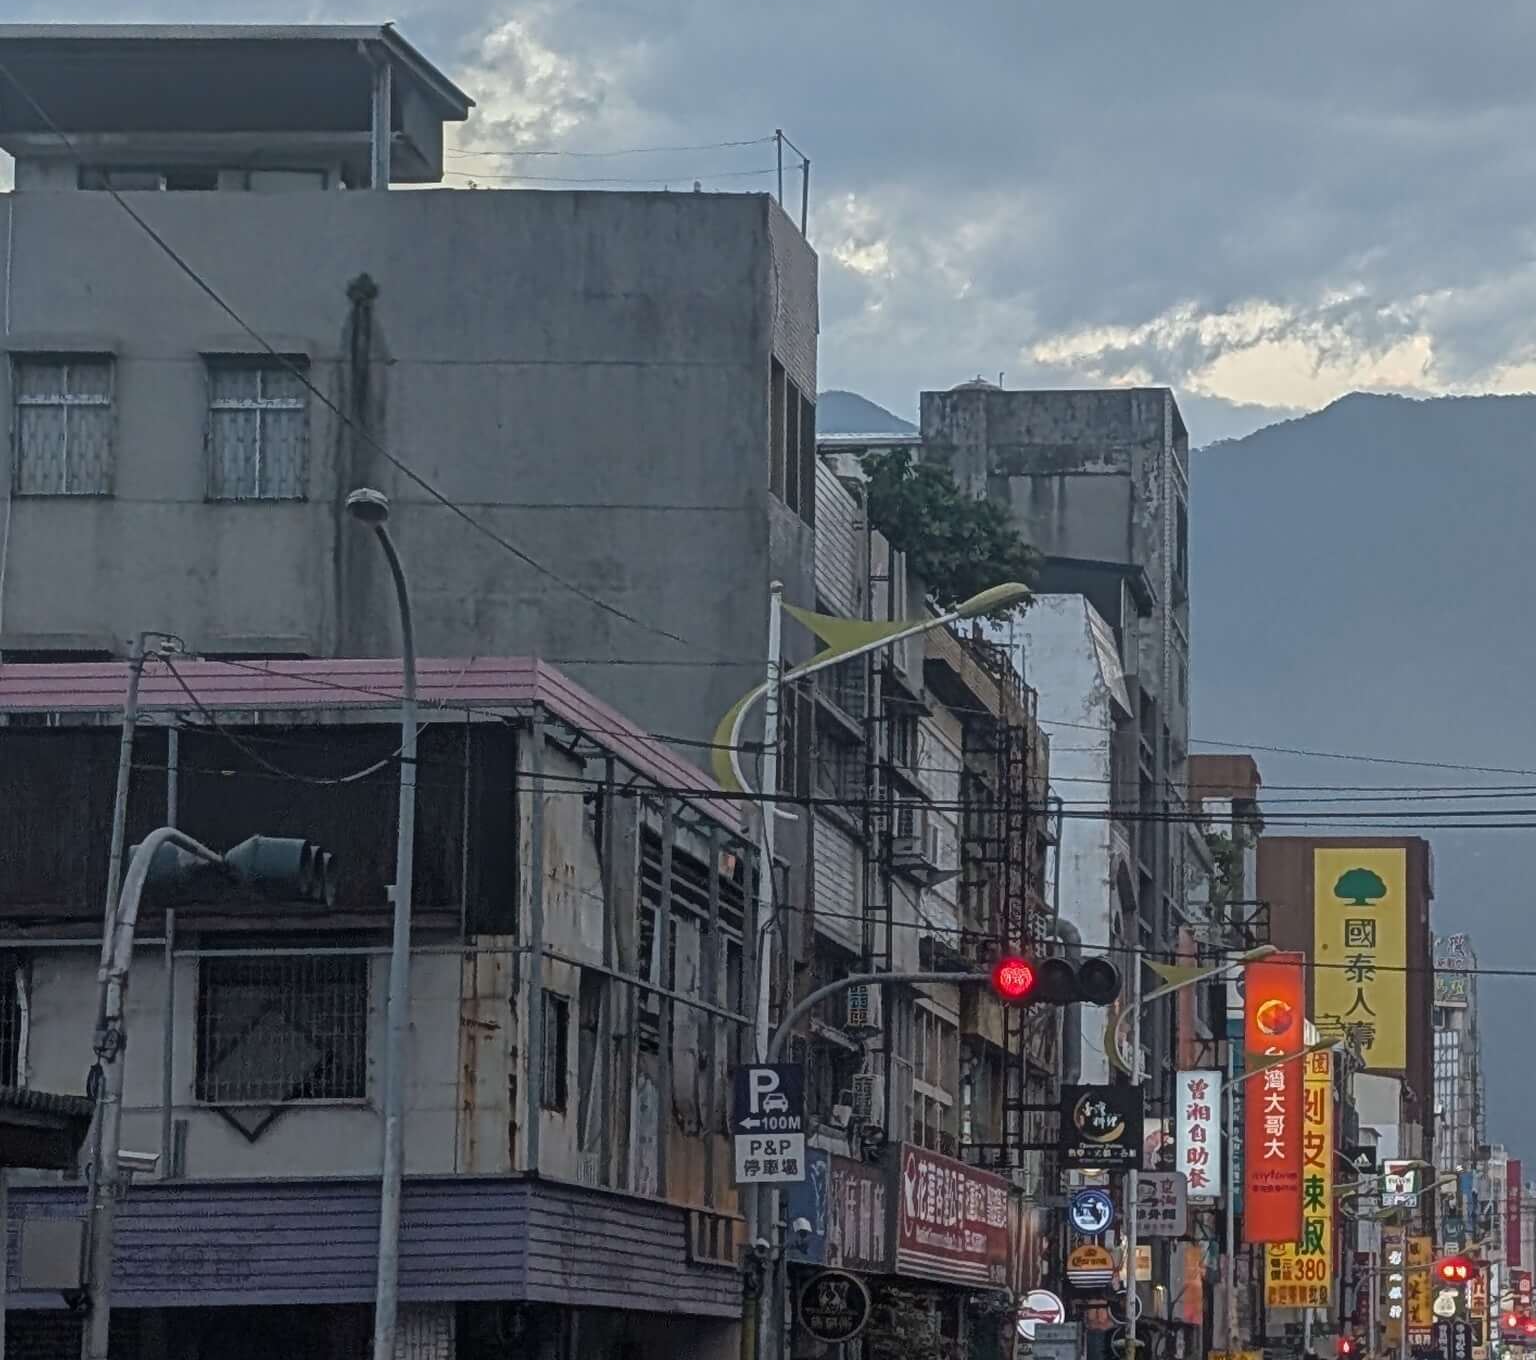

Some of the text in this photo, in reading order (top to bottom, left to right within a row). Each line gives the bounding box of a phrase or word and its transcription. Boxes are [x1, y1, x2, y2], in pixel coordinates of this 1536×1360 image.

[1344, 918, 1377, 1051] 國泰人壽
[749, 1069, 780, 1113] P
[761, 1116, 801, 1130] 100M
[750, 1140, 791, 1155] P&P
[744, 1158, 798, 1176] 停車場
[1294, 1259, 1327, 1281] 380
